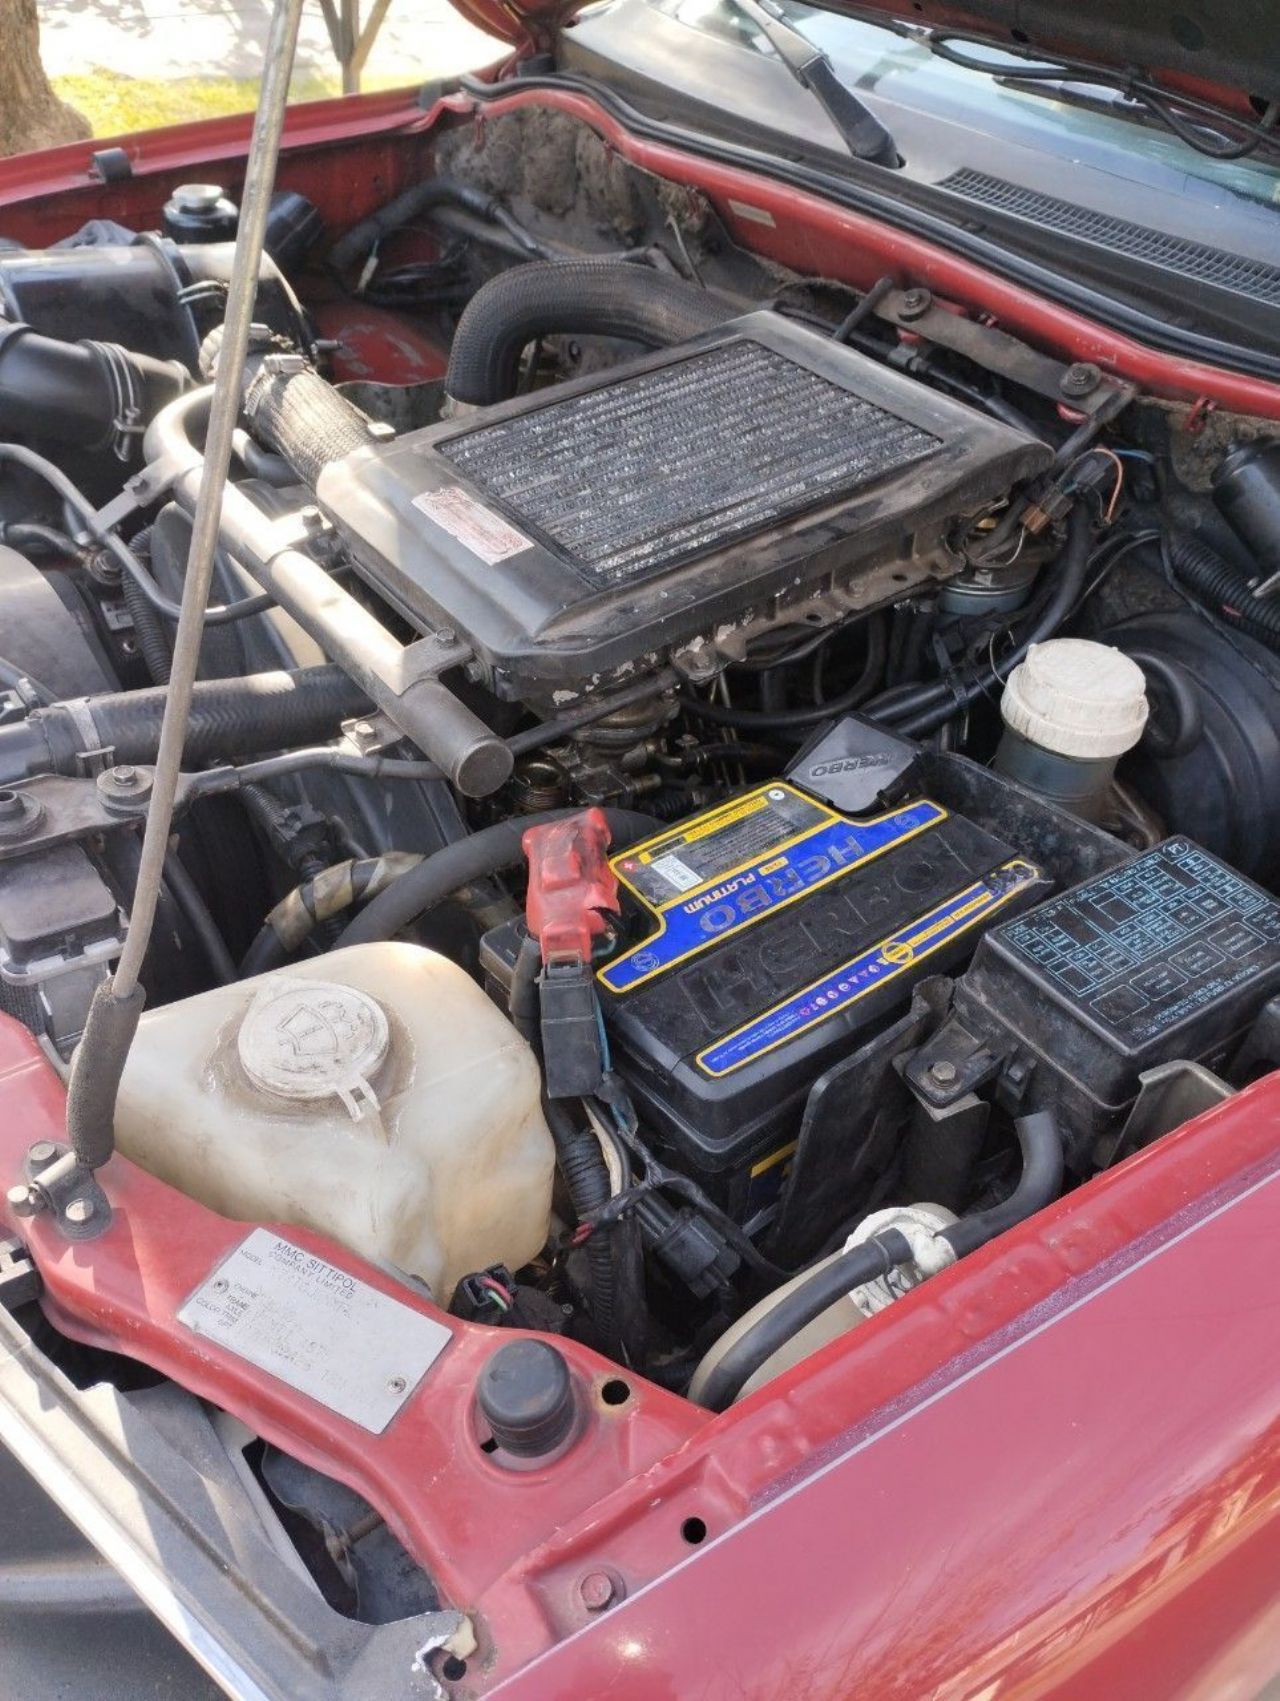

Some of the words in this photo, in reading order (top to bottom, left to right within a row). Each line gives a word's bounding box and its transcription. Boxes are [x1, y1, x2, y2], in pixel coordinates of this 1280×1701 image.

[699, 835, 865, 933] HERBO
[268, 1250, 315, 1280] COMPANY
[315, 1275, 354, 1299] LIMITED
[275, 1241, 305, 1262] MMC
[306, 1257, 358, 1292] SITTIPOL
